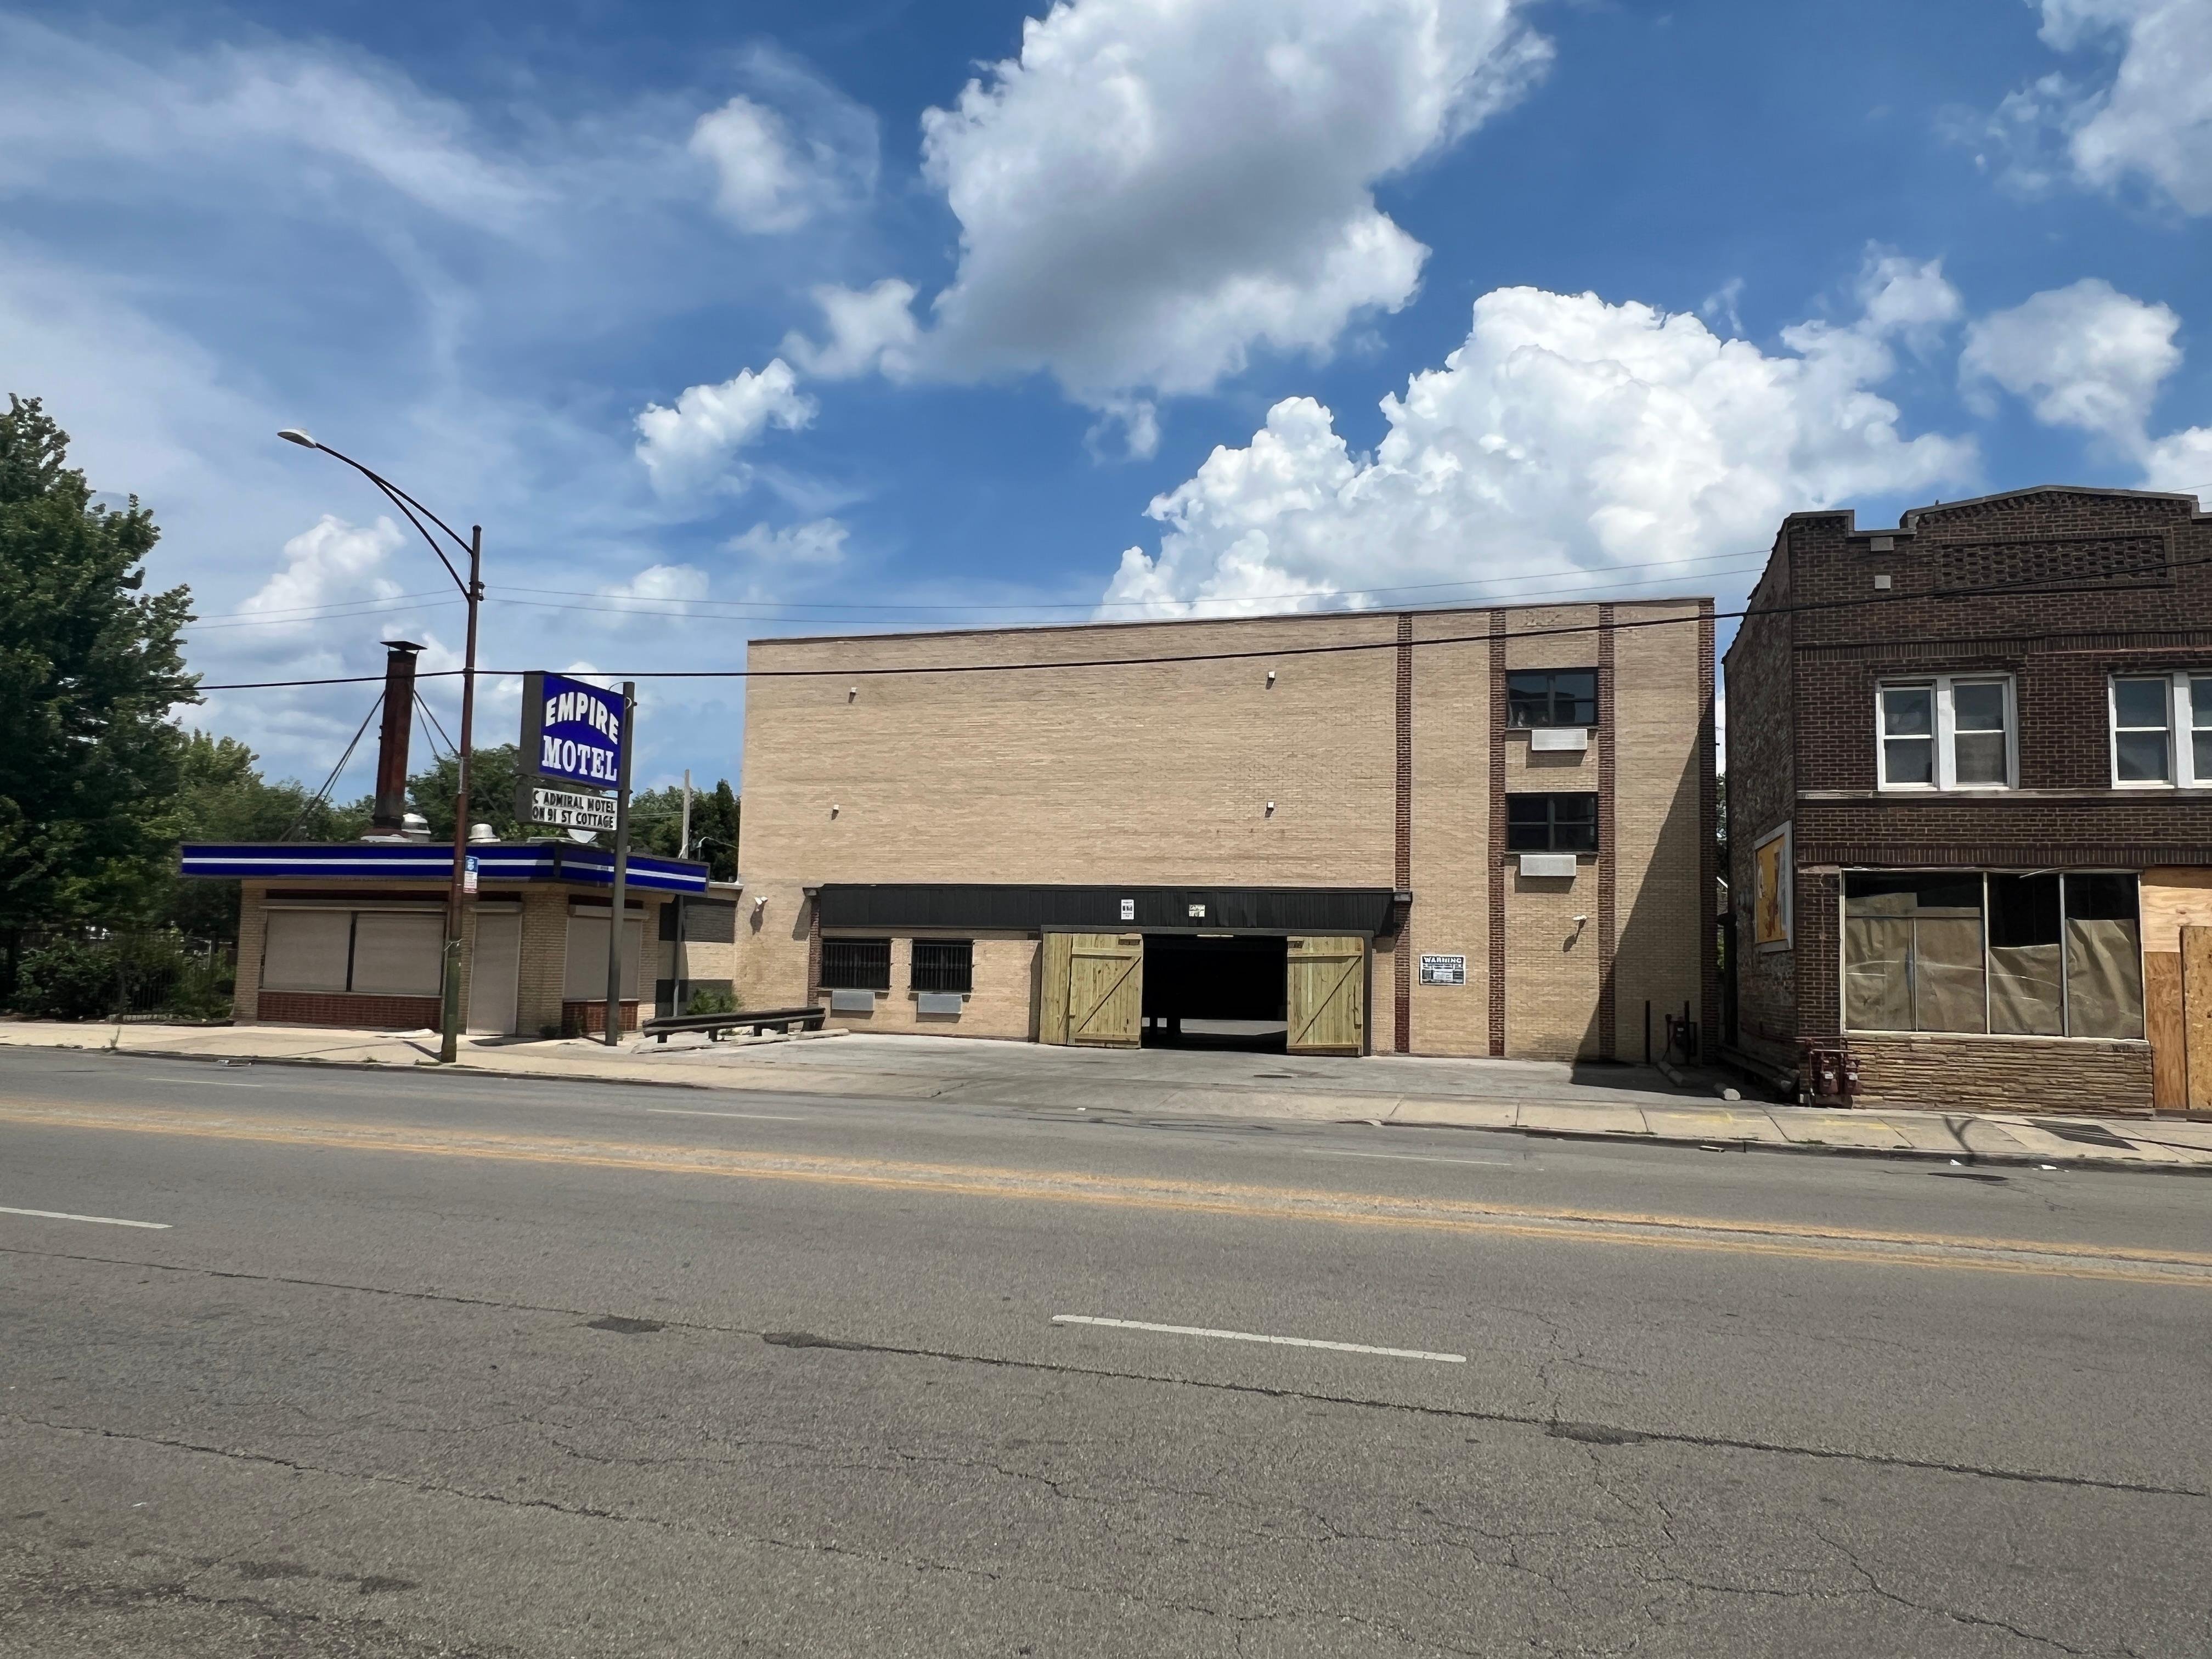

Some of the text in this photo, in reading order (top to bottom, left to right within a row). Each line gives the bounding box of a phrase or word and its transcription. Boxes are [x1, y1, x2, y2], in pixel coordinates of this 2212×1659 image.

[546, 692, 619, 744] EMPIRE
[541, 735, 617, 781] MOTEL
[533, 806, 545, 820] ON
[561, 810, 572, 823] ST
[576, 812, 613, 828] COTTAGE
[544, 792, 584, 810] ADMIRAL
